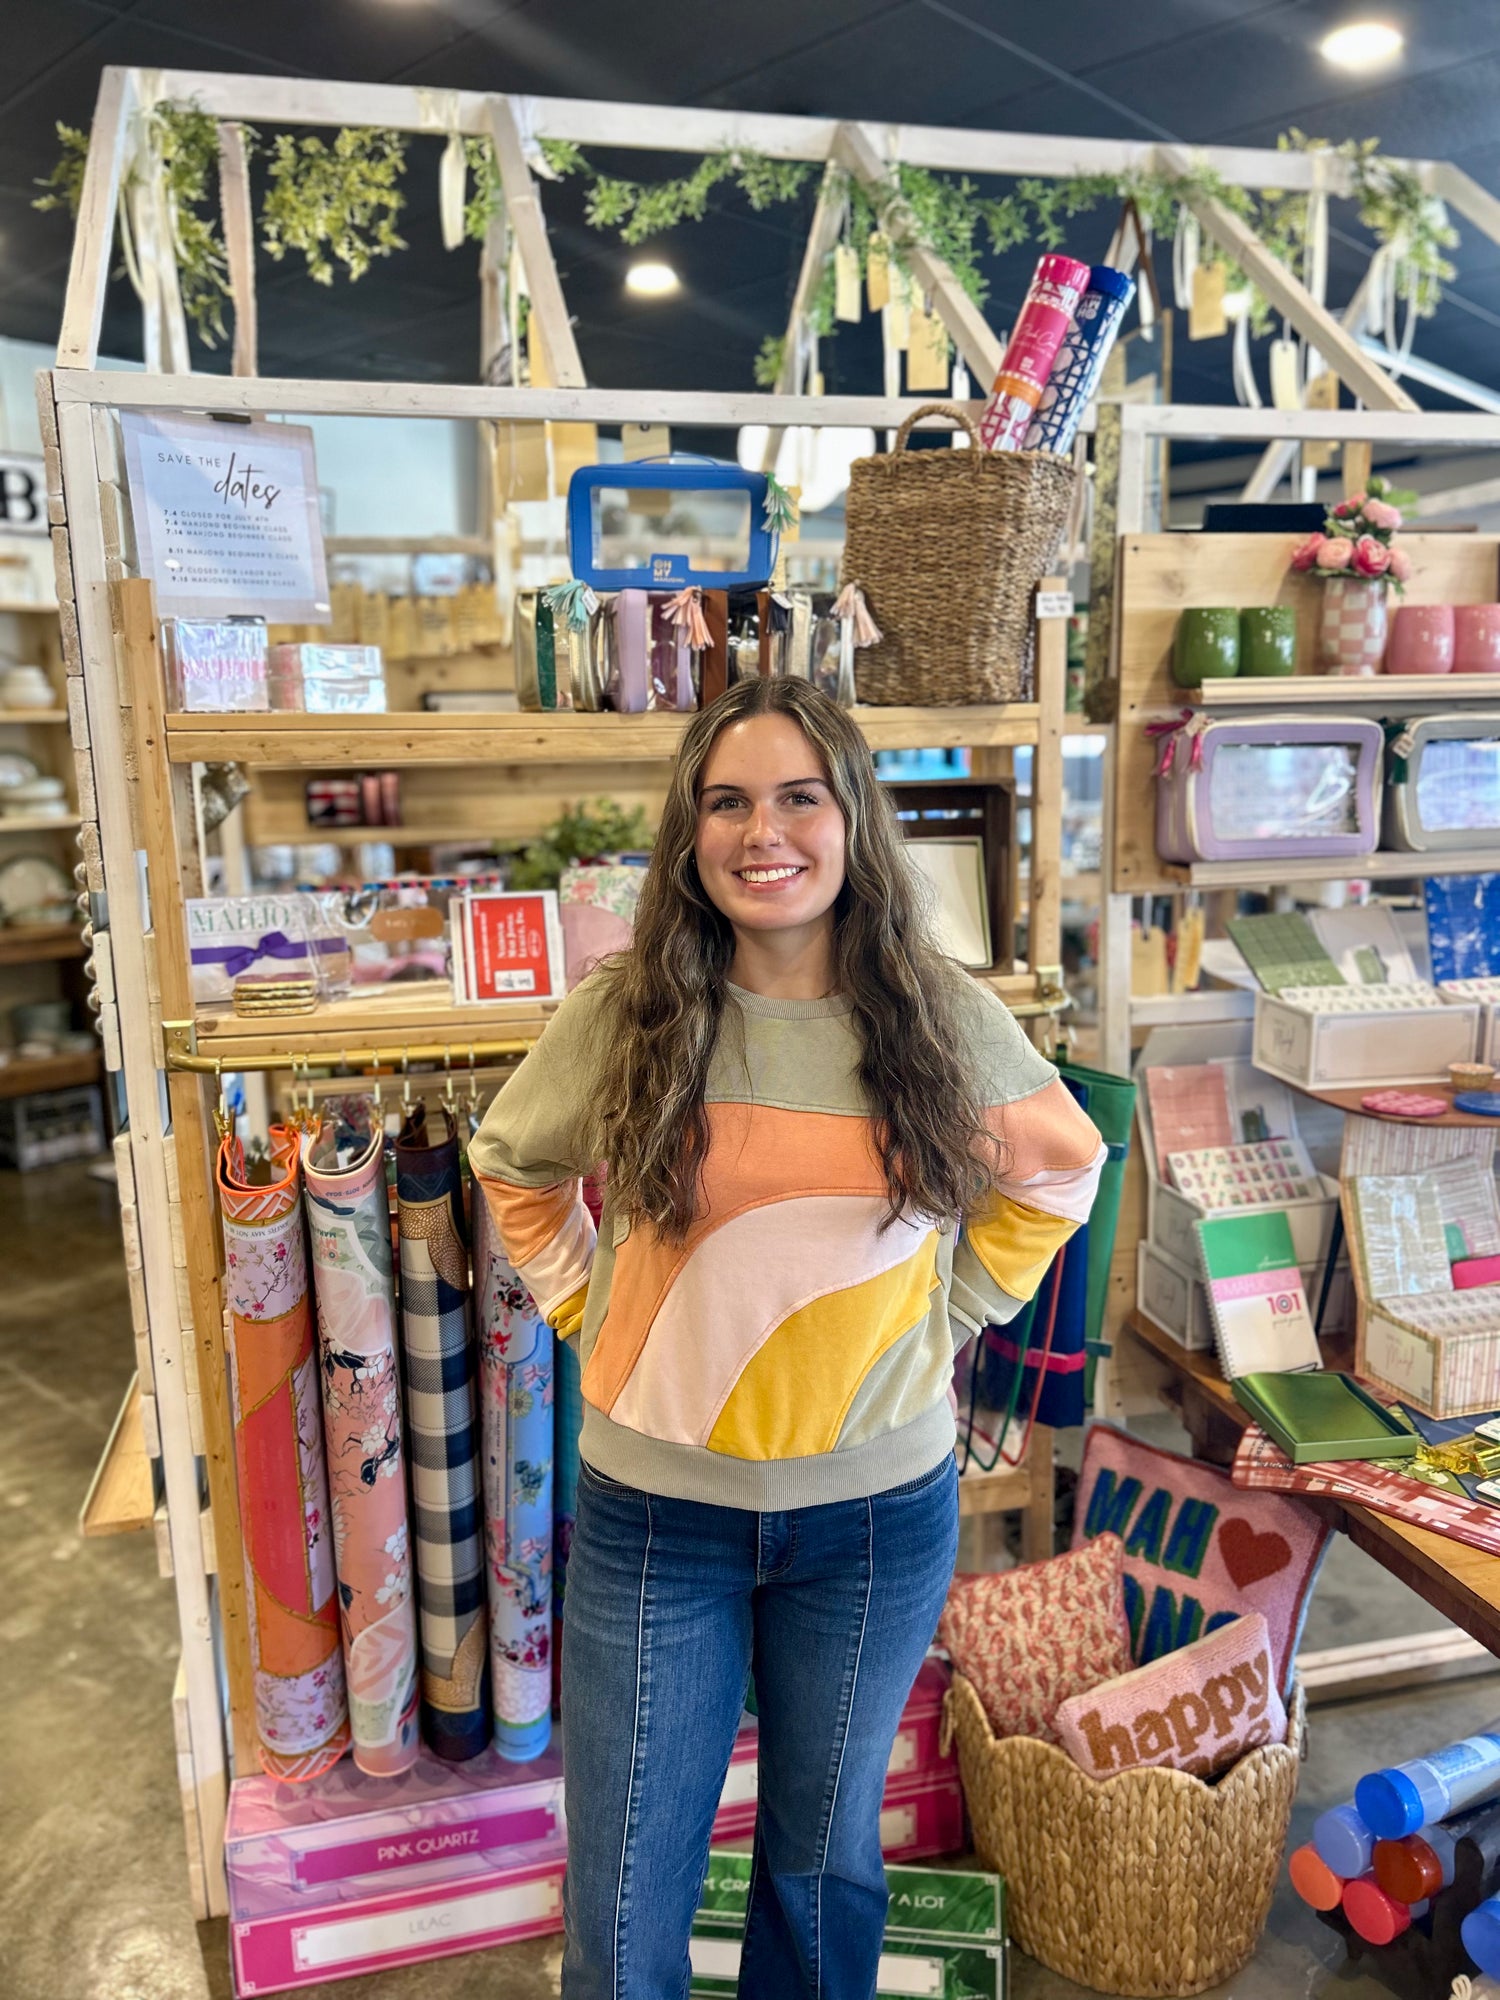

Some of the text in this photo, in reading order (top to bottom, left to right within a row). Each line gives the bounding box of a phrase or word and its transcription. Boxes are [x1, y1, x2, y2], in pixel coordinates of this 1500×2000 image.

[158, 453, 221, 468] SAVE THE
[214, 452, 281, 509] dates
[181, 511, 213, 519] CLOSED
[181, 521, 220, 529] MAHJONG
[223, 523, 261, 531] BEGINNER
[263, 525, 288, 533] CLASS
[187, 530, 224, 538] MAHJONG
[228, 532, 265, 540] BEGINNER
[267, 534, 293, 542] CLASS
[187, 549, 225, 557] MAHJONG
[191, 577, 229, 585] MAHJONG
[250, 1229, 267, 1238] MAY
[1267, 1293, 1301, 1315] 101
[1083, 1467, 1220, 1579] MAH
[1077, 1652, 1270, 1770] happy
[377, 1829, 480, 1862] PINK QUARTZ
[914, 1895, 946, 1910] LOT
[409, 1913, 452, 1934] LILAC
